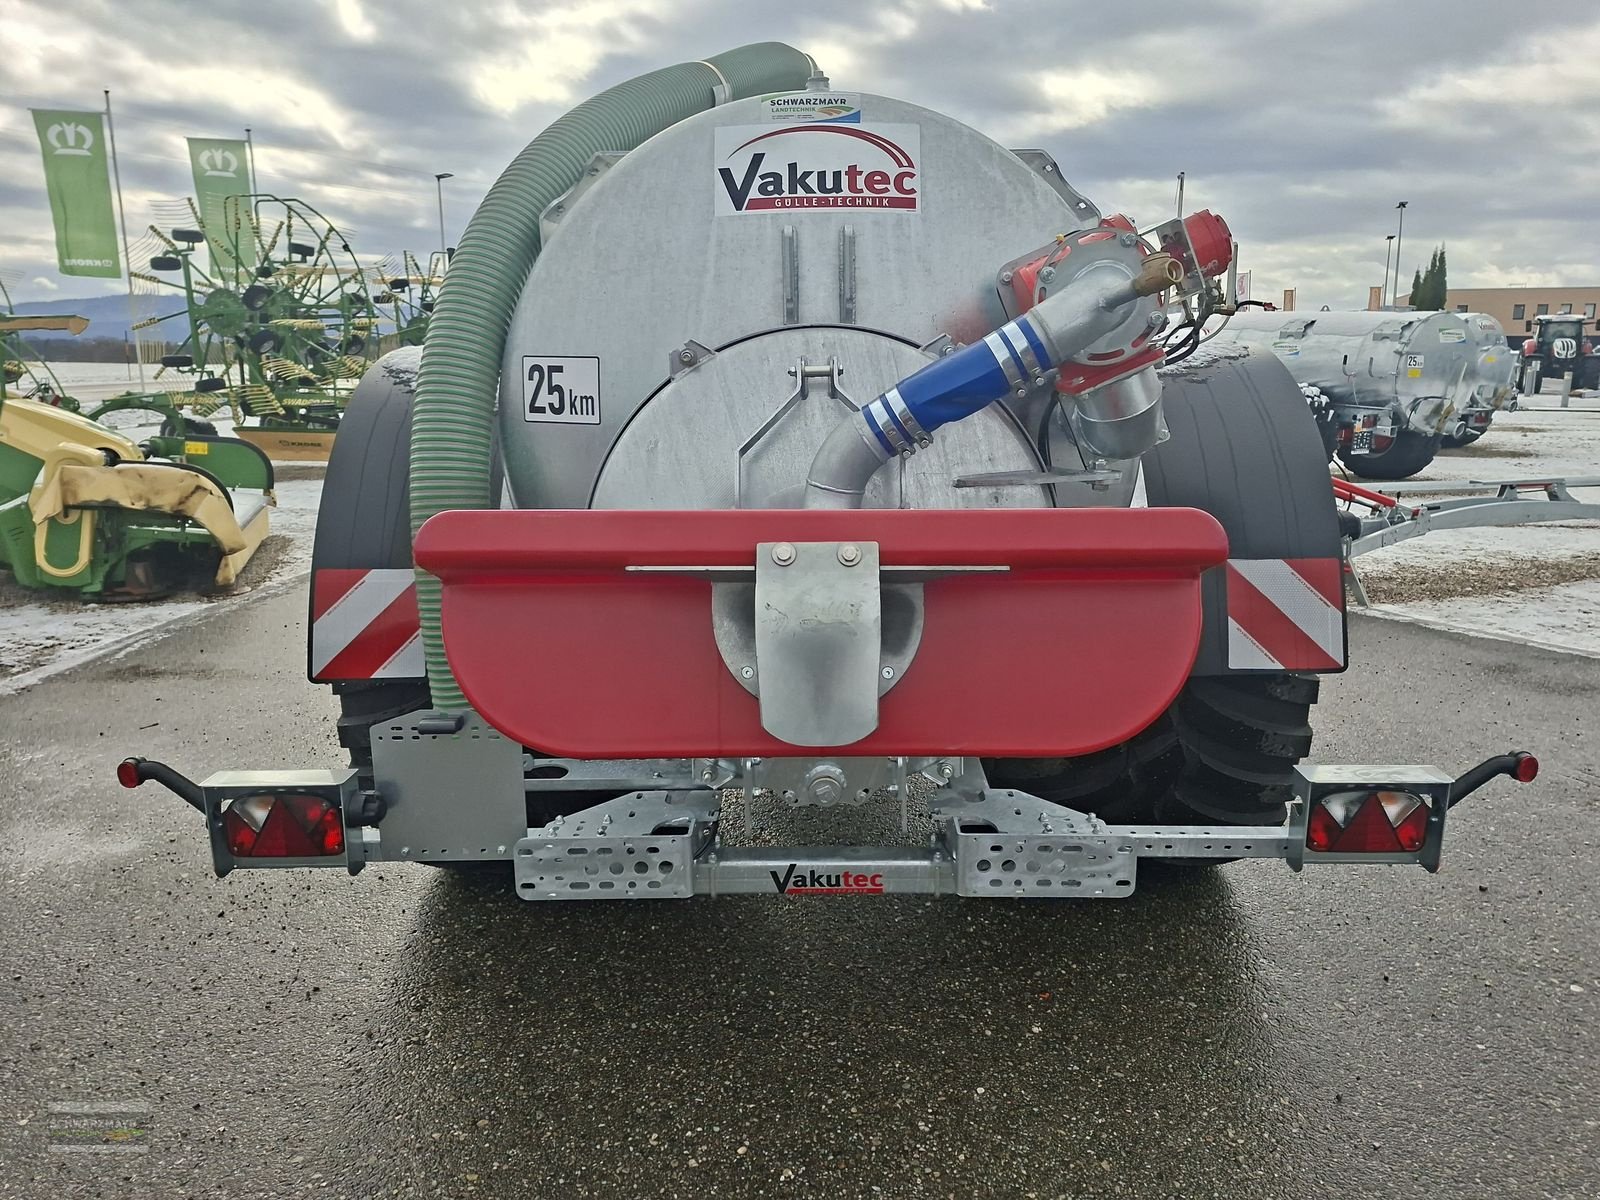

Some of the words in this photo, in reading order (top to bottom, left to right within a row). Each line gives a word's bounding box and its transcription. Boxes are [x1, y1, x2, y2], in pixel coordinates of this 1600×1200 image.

[770, 98, 847, 107] SCHWARZMAYR
[717, 152, 918, 212] Vakutec
[1408, 356, 1418, 367] 25
[528, 363, 566, 416] 25
[568, 388, 595, 416] km
[769, 863, 884, 894] Vakutec
